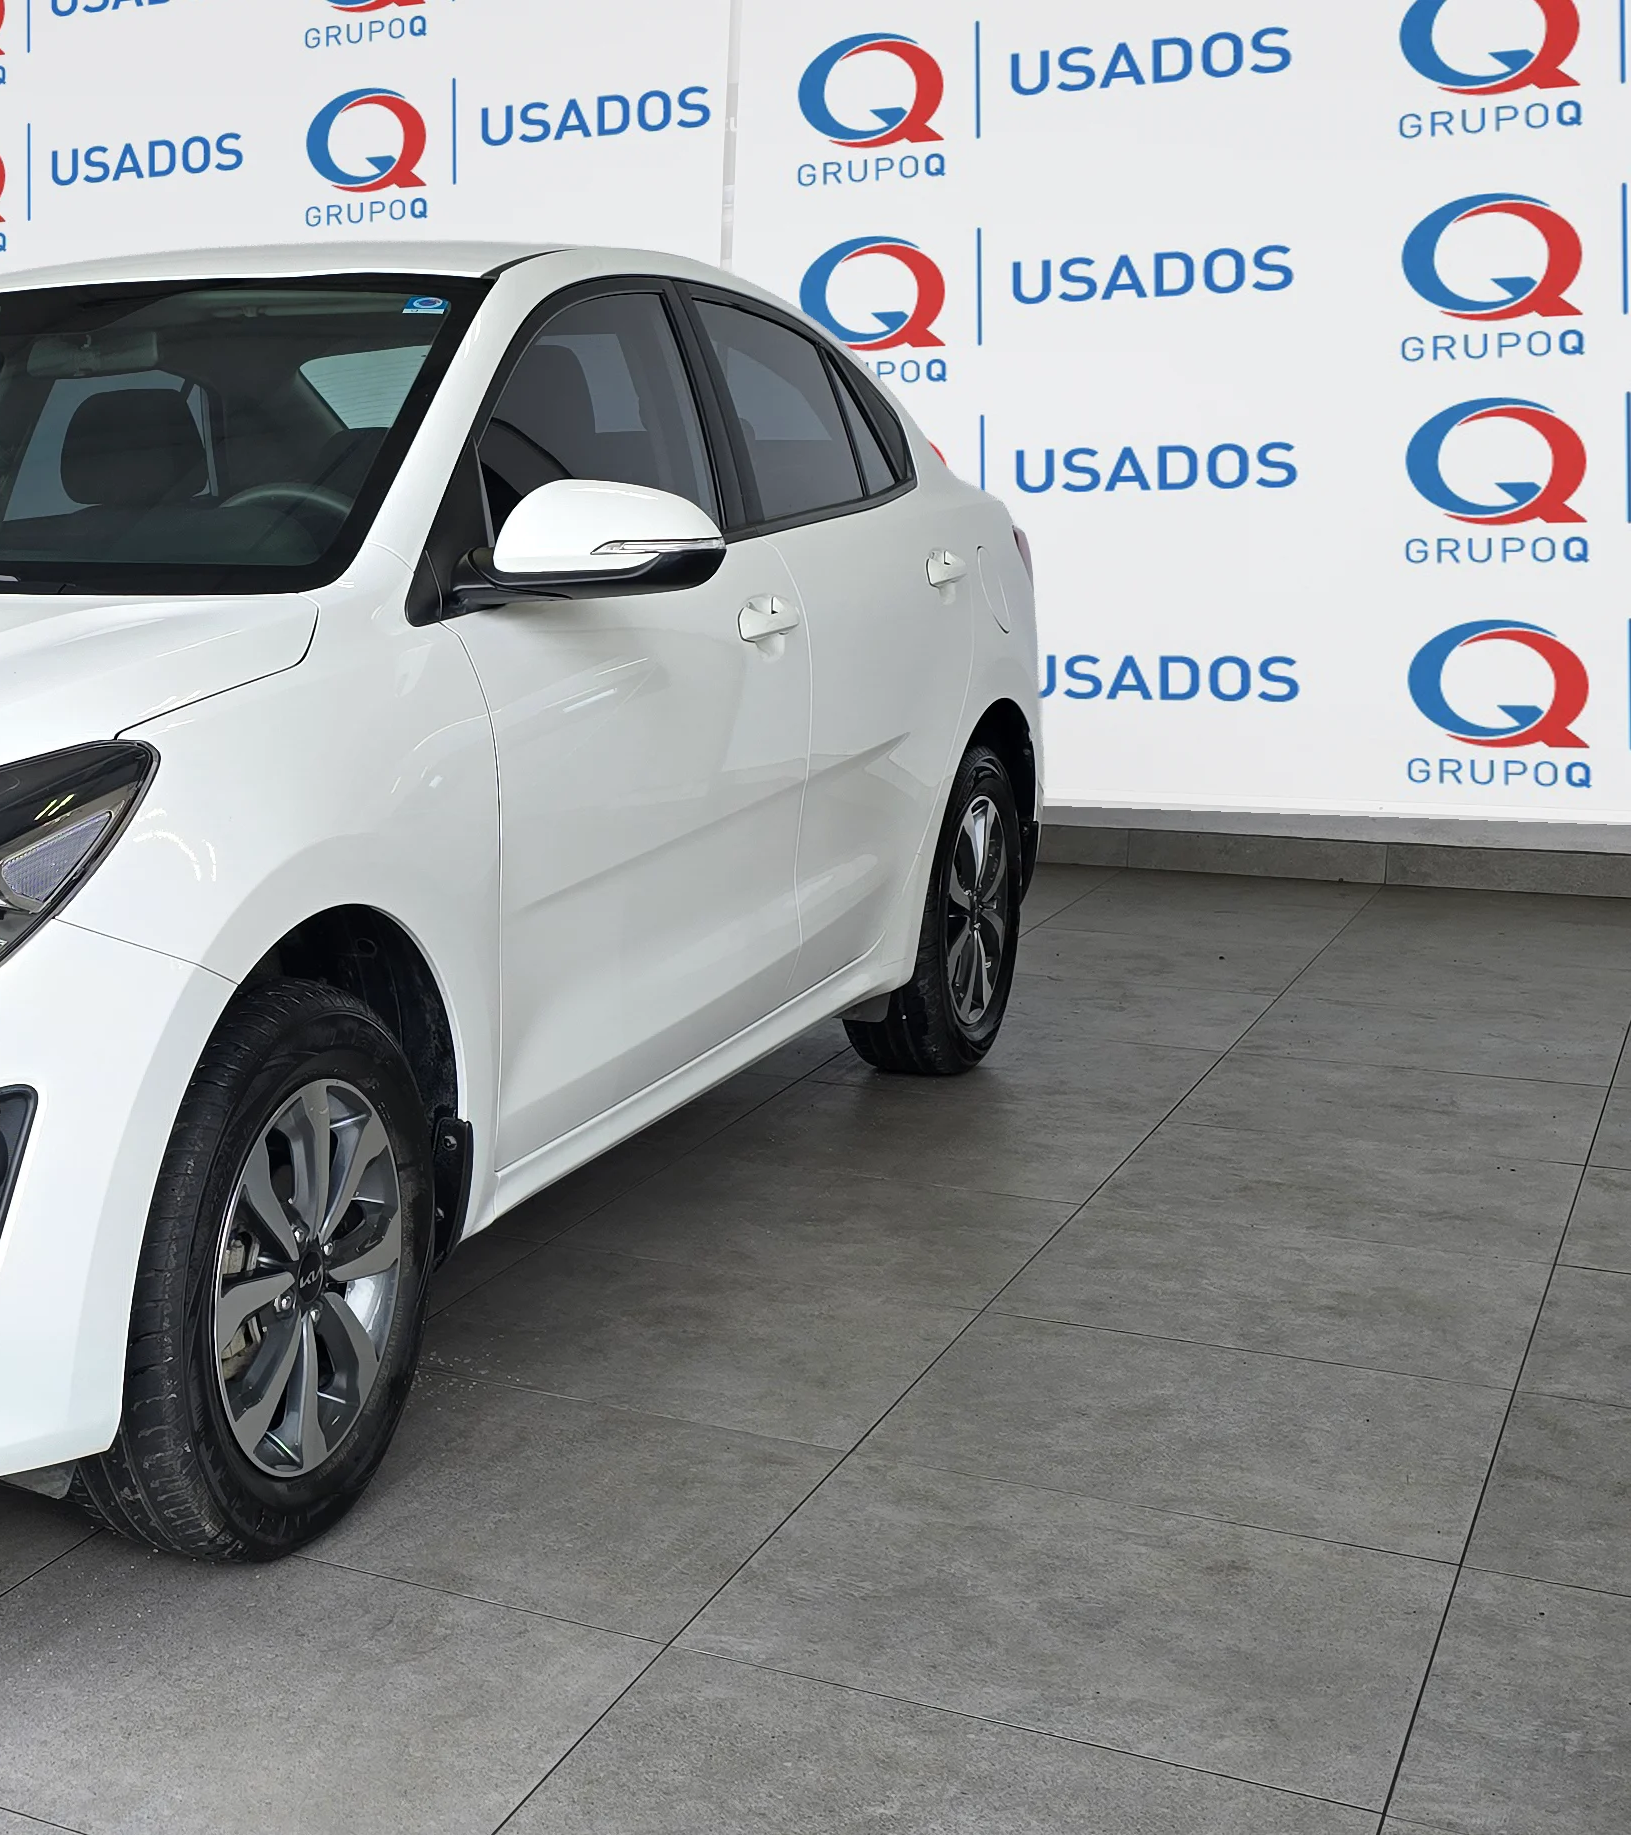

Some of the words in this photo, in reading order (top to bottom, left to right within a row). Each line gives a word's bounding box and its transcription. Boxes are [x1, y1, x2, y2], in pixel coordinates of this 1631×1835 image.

[304, 16, 428, 48] GRUPOQ
[1010, 26, 1291, 96] USADOS
[481, 85, 711, 147] USADOS
[1398, 100, 1583, 139] GRUPOQ
[51, 133, 244, 186] USADOS
[797, 153, 945, 187] GRUPOQ
[305, 197, 428, 227] GRUPOQ
[1011, 244, 1293, 305] USADOS
[1400, 329, 1585, 362] GRUPOQ
[1015, 441, 1298, 494] USADOS
[1405, 536, 1588, 563] GRUPOQ
[1407, 758, 1592, 788] GRUPOQ
